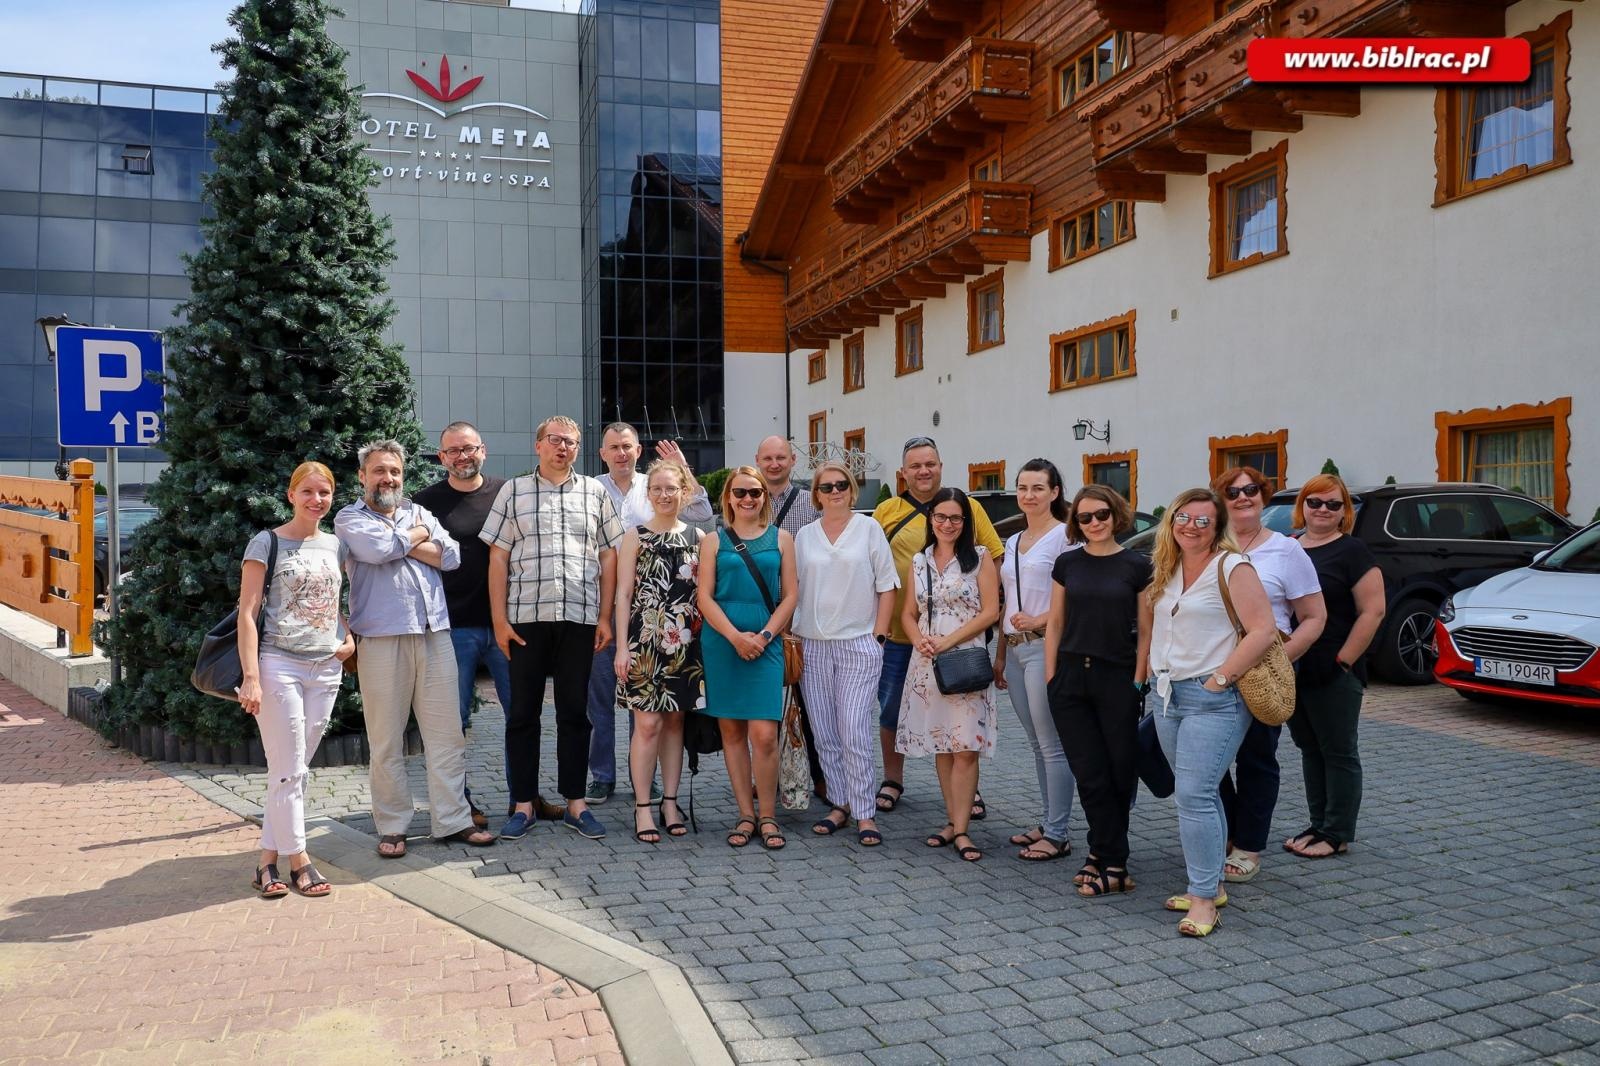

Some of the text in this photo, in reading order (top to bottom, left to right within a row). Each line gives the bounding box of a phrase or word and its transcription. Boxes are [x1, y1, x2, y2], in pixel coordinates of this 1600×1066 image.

[361, 118, 550, 149] OTEL META
[83, 339, 142, 411] P
[136, 411, 161, 444] B
[1483, 660, 1551, 680] ST 1904R
